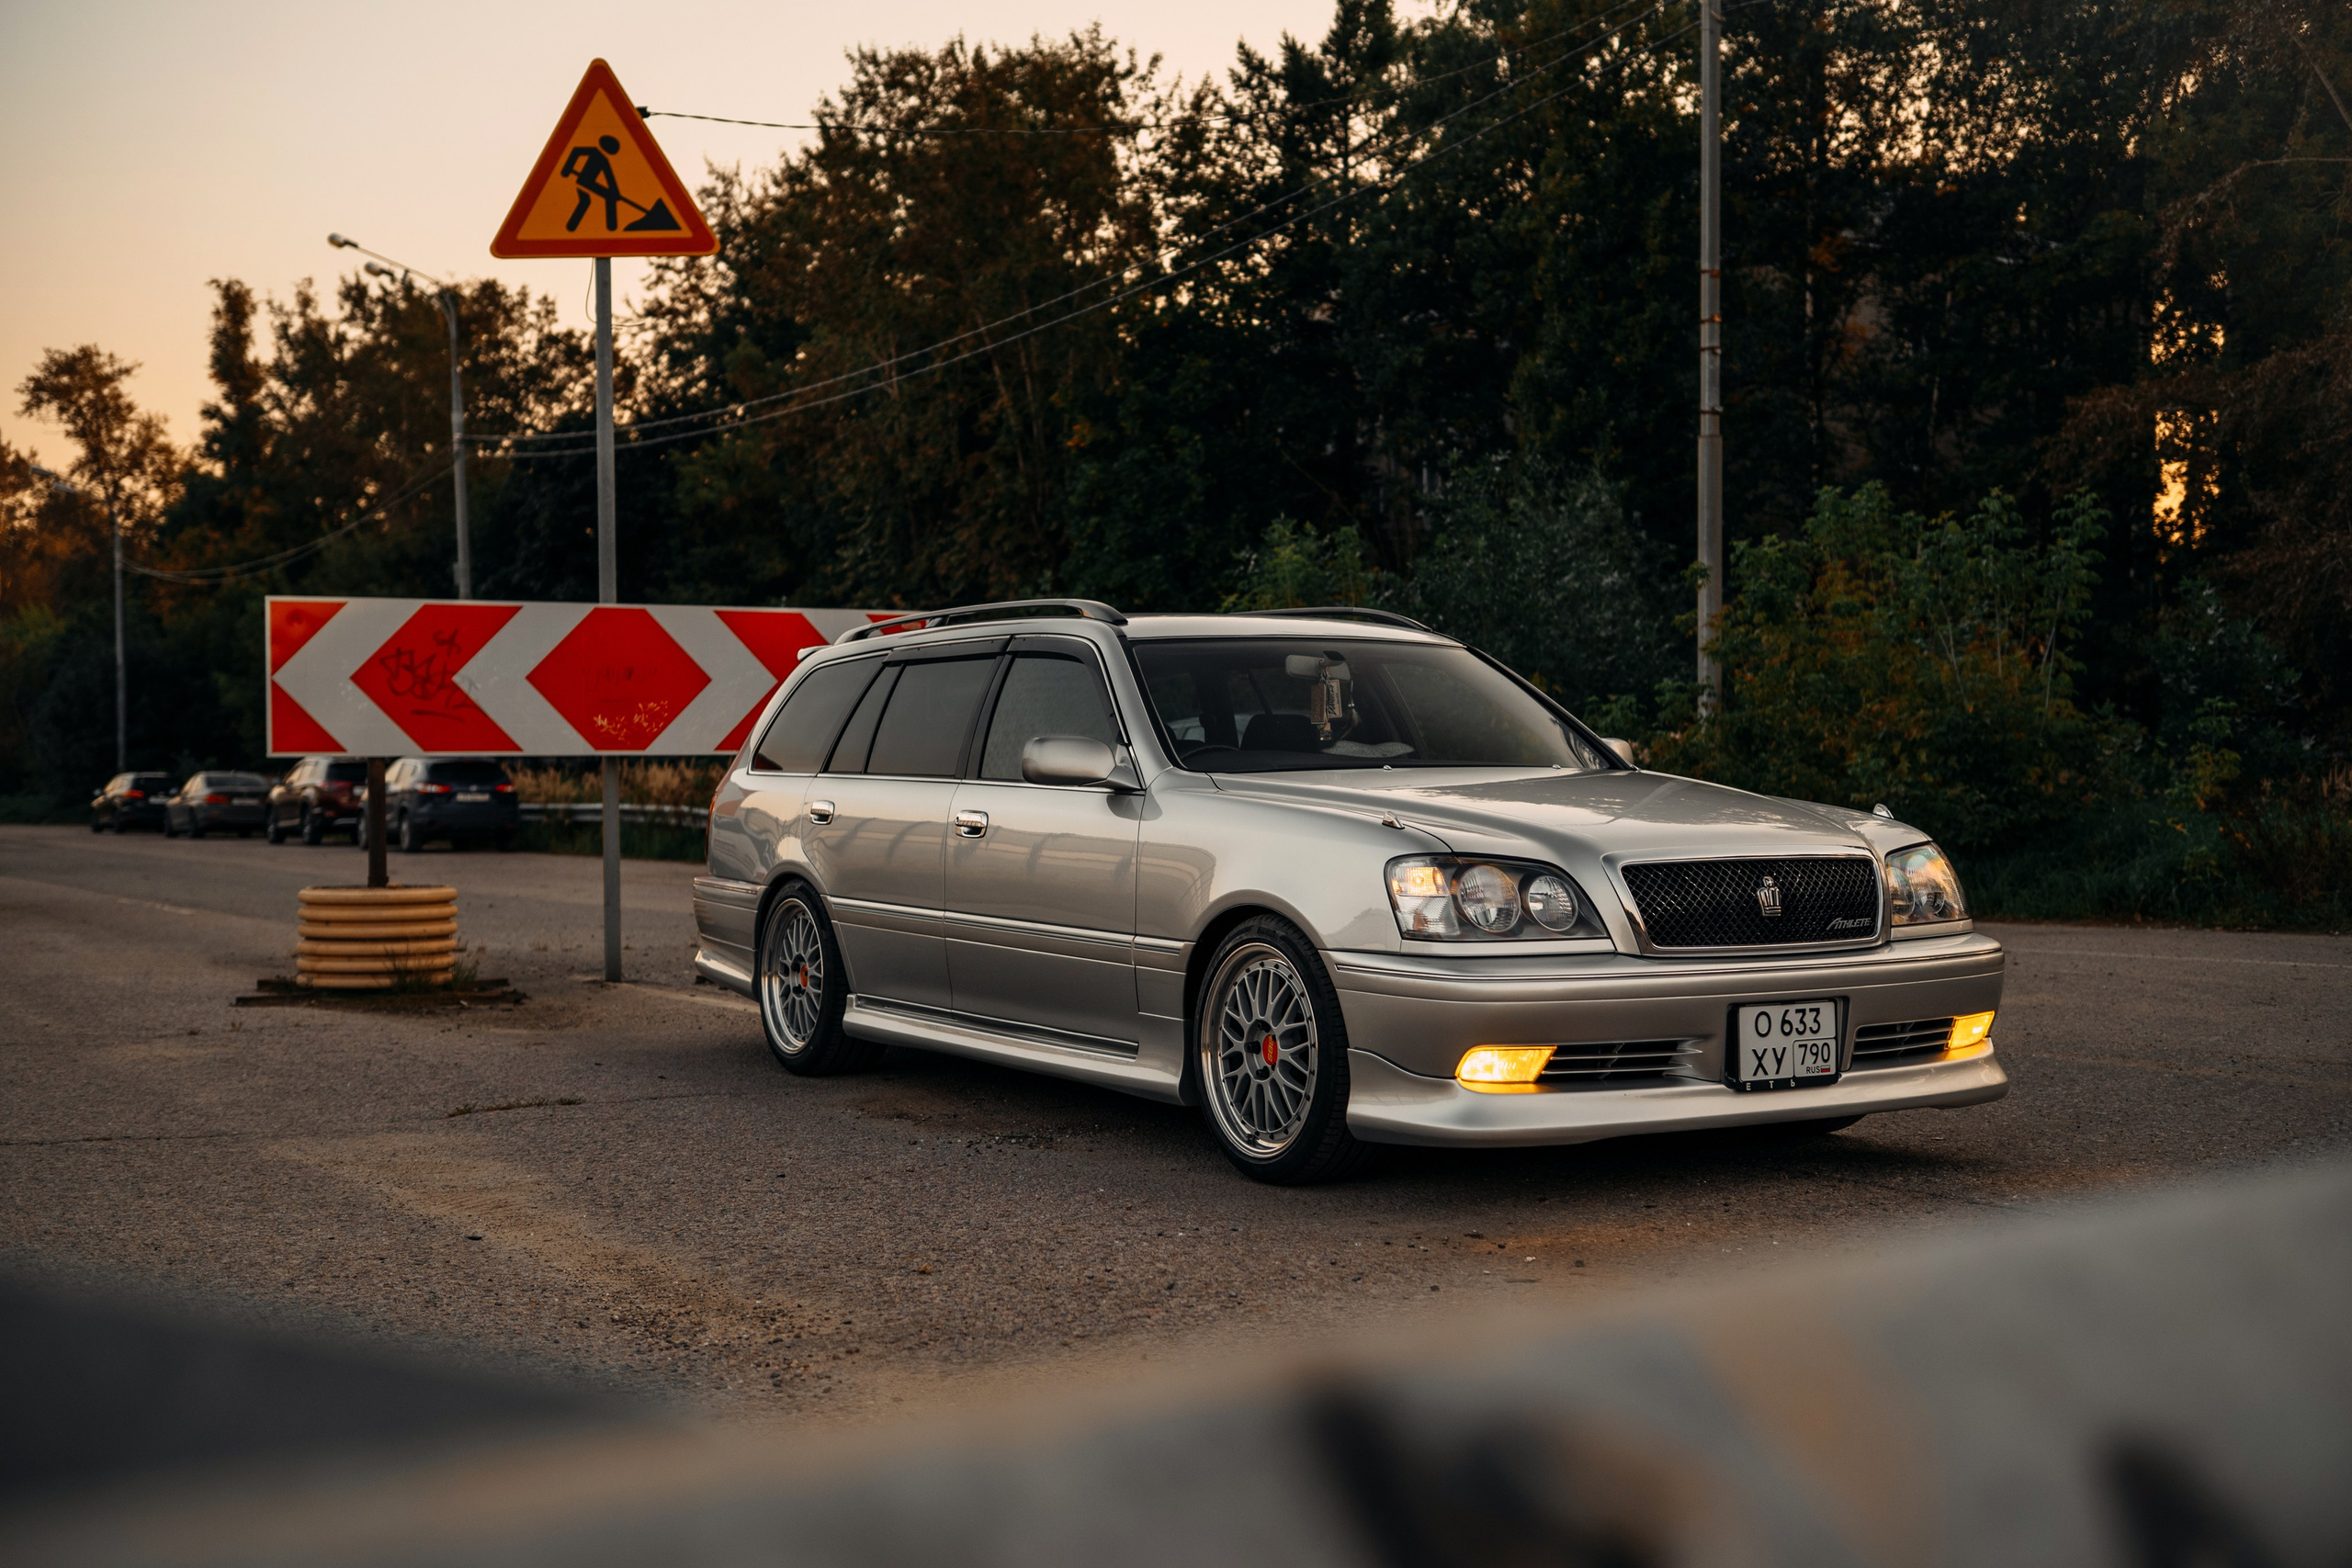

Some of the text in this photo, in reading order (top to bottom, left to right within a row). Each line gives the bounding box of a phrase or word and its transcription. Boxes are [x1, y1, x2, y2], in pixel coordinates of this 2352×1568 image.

[1780, 1007, 1821, 1037] 633
[1798, 1042, 1831, 1066] 790
[1805, 1066, 1821, 1074] RUS
